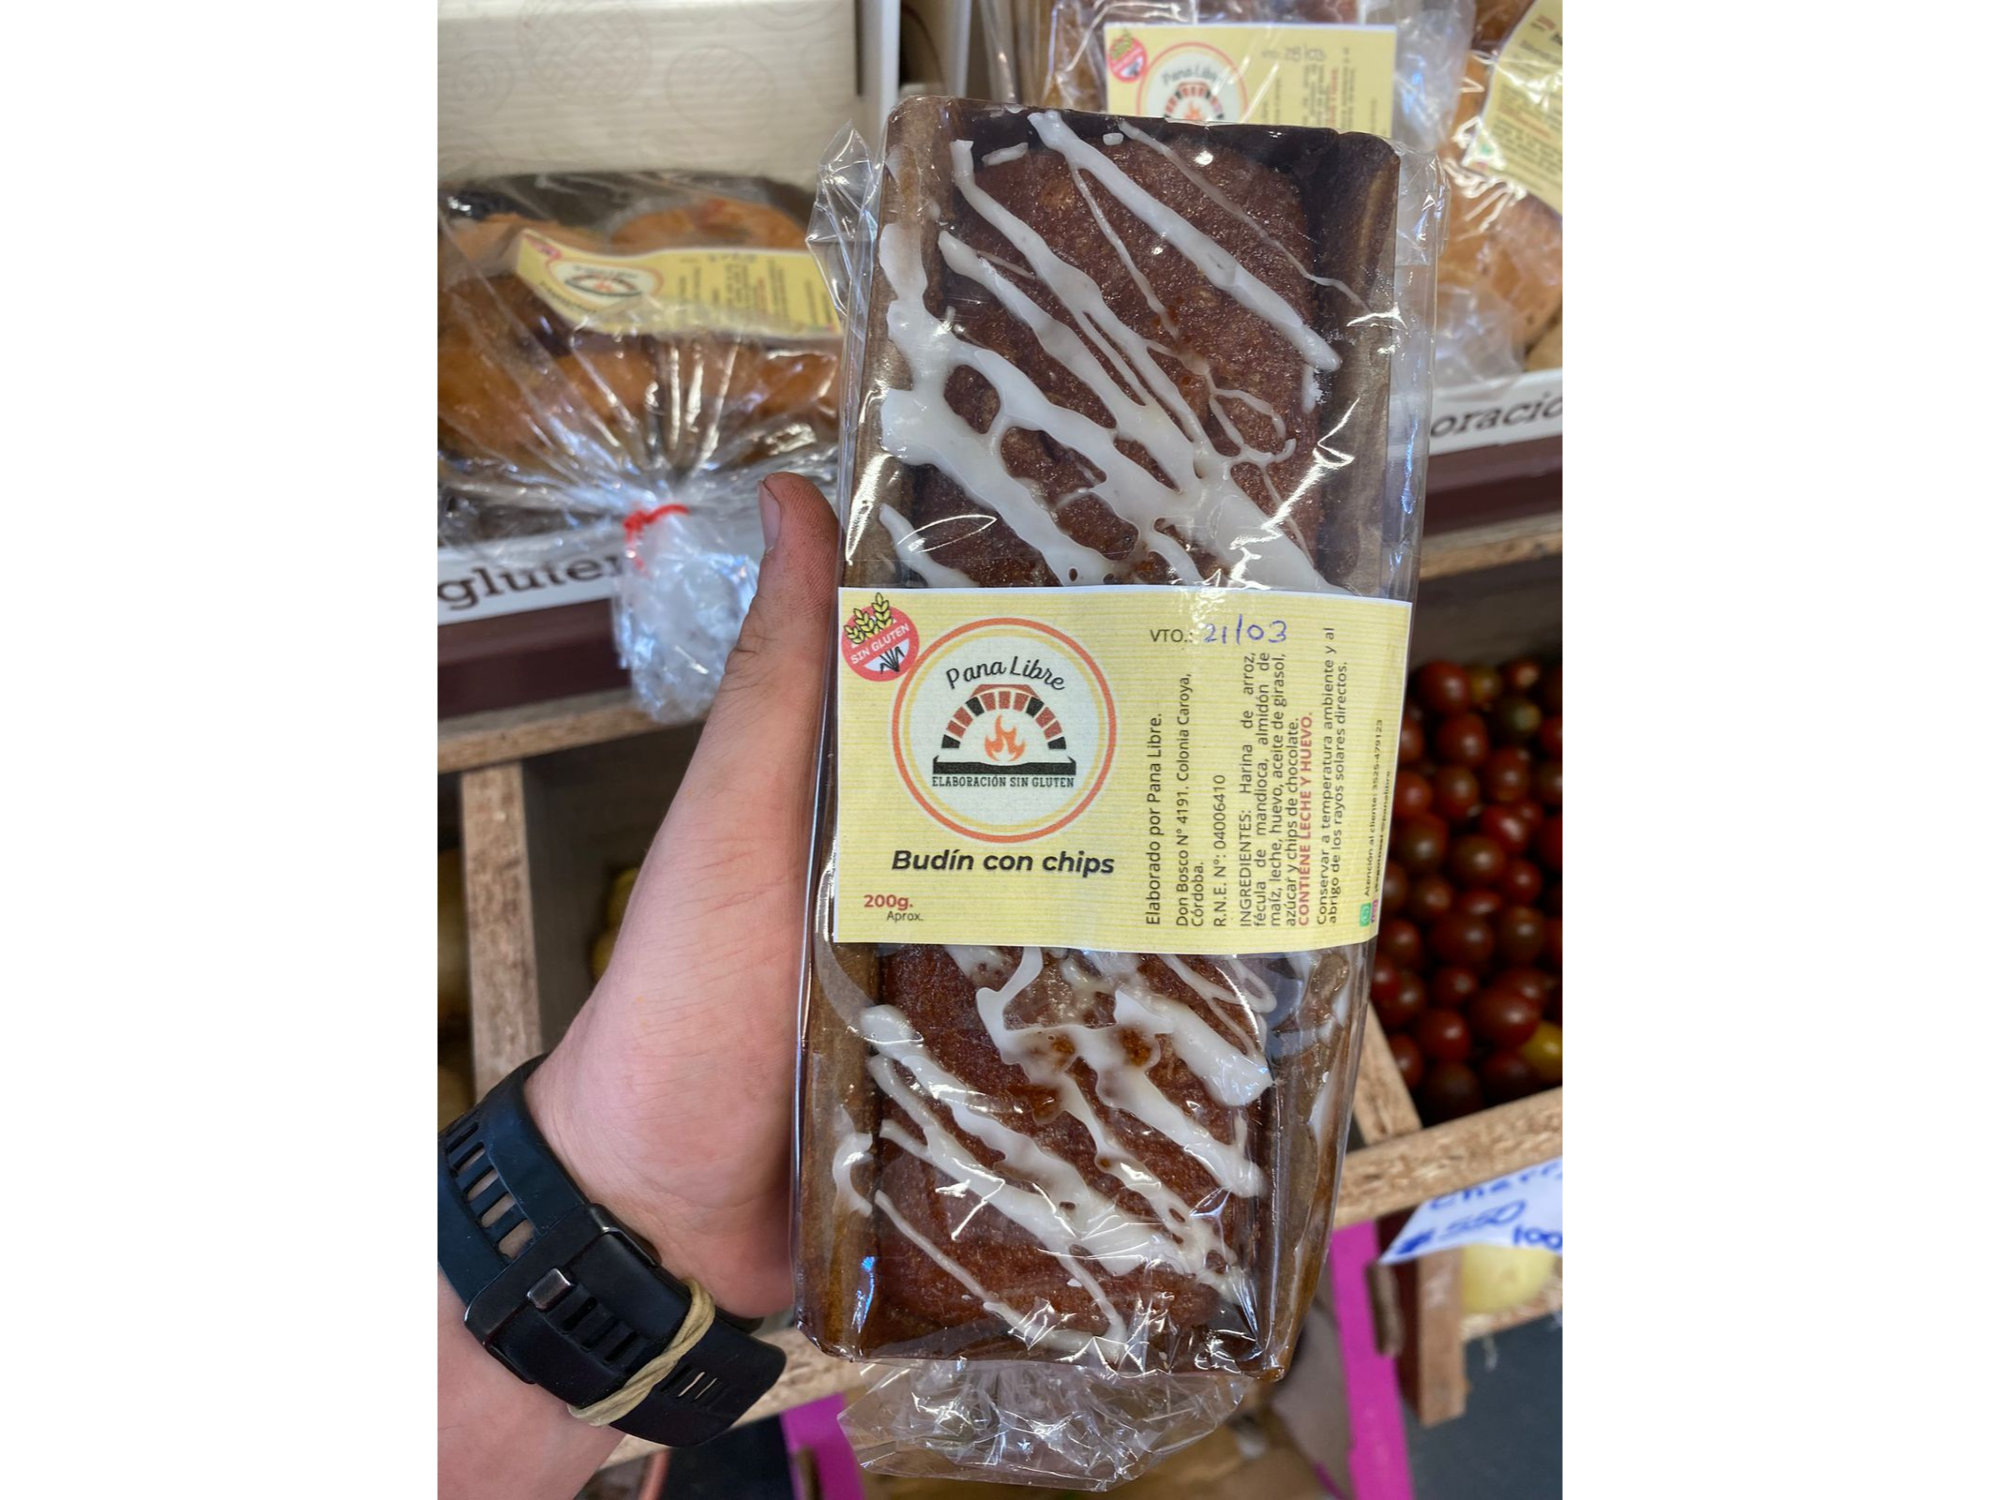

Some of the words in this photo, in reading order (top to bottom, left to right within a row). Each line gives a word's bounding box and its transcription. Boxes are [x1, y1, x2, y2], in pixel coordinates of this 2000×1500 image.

[1430, 390, 1563, 438] oraci
[850, 647, 870, 665] SIN
[871, 623, 910, 652] GLUTEN
[1322, 628, 1334, 640] al
[1324, 646, 1336, 654] y
[945, 661, 1007, 690] Pana
[1009, 655, 1066, 691] Libre
[1242, 652, 1256, 695] arroz,
[1256, 652, 1270, 672] de
[1271, 654, 1288, 707] girasol,
[1178, 674, 1193, 725] Caroya,
[1321, 660, 1334, 730] ambiente
[1334, 661, 1348, 724] directos.
[1146, 713, 1162, 758] Libre.
[1240, 710, 1254, 729] de
[1255, 684, 1269, 746] almidón
[1270, 711, 1284, 730] de
[1176, 729, 1190, 782] Colonia
[1270, 734, 1284, 779] aceite
[1286, 718, 1299, 793] chocolate.
[1300, 712, 1313, 772] HUEVO.
[1334, 728, 1346, 781] solares
[932, 774, 1006, 787] ELABORACIÓN
[1010, 776, 1029, 787] SIN
[1032, 777, 1074, 788] GLUTEN
[1146, 763, 1161, 803] Pana
[1239, 744, 1253, 794] Harina
[1300, 776, 1312, 786] Y
[1321, 736, 1332, 829] temperatura
[1176, 786, 1189, 824] 4191.
[1212, 774, 1226, 850] 04006410
[1254, 758, 1269, 836] mandioca,
[1268, 784, 1284, 834] huevo,
[1286, 798, 1298, 816] de
[1298, 790, 1312, 840] LECHE
[1334, 785, 1346, 825] rayos
[1149, 808, 1164, 836] por
[1284, 821, 1301, 860] chips
[1321, 835, 1330, 844] a
[1331, 829, 1342, 850] los
[1368, 835, 1375, 846] al
[891, 849, 975, 871] Budín
[983, 854, 1033, 871] con
[1042, 850, 1115, 878] chips
[1176, 850, 1189, 892] Bosco
[1239, 810, 1252, 927] INGREDIENTES:
[1254, 849, 1266, 868] de
[1268, 839, 1283, 882] leche,
[1287, 864, 1301, 873] y
[1331, 854, 1340, 873] de
[1364, 848, 1374, 897] Atención
[863, 894, 913, 911] 200g.
[1145, 841, 1161, 925] Elaborado
[1190, 862, 1204, 927] Córdoba.
[1213, 882, 1227, 927] R.N.E.
[1253, 881, 1267, 927] fécula
[1284, 877, 1297, 927] azúcar
[1298, 845, 1311, 926] CONTIENE
[1316, 850, 1330, 925] Conservar
[1327, 877, 1341, 924] abrigo
[886, 910, 924, 923] Aprox.
[1175, 897, 1189, 927] Don
[1268, 888, 1283, 927] maíz,
